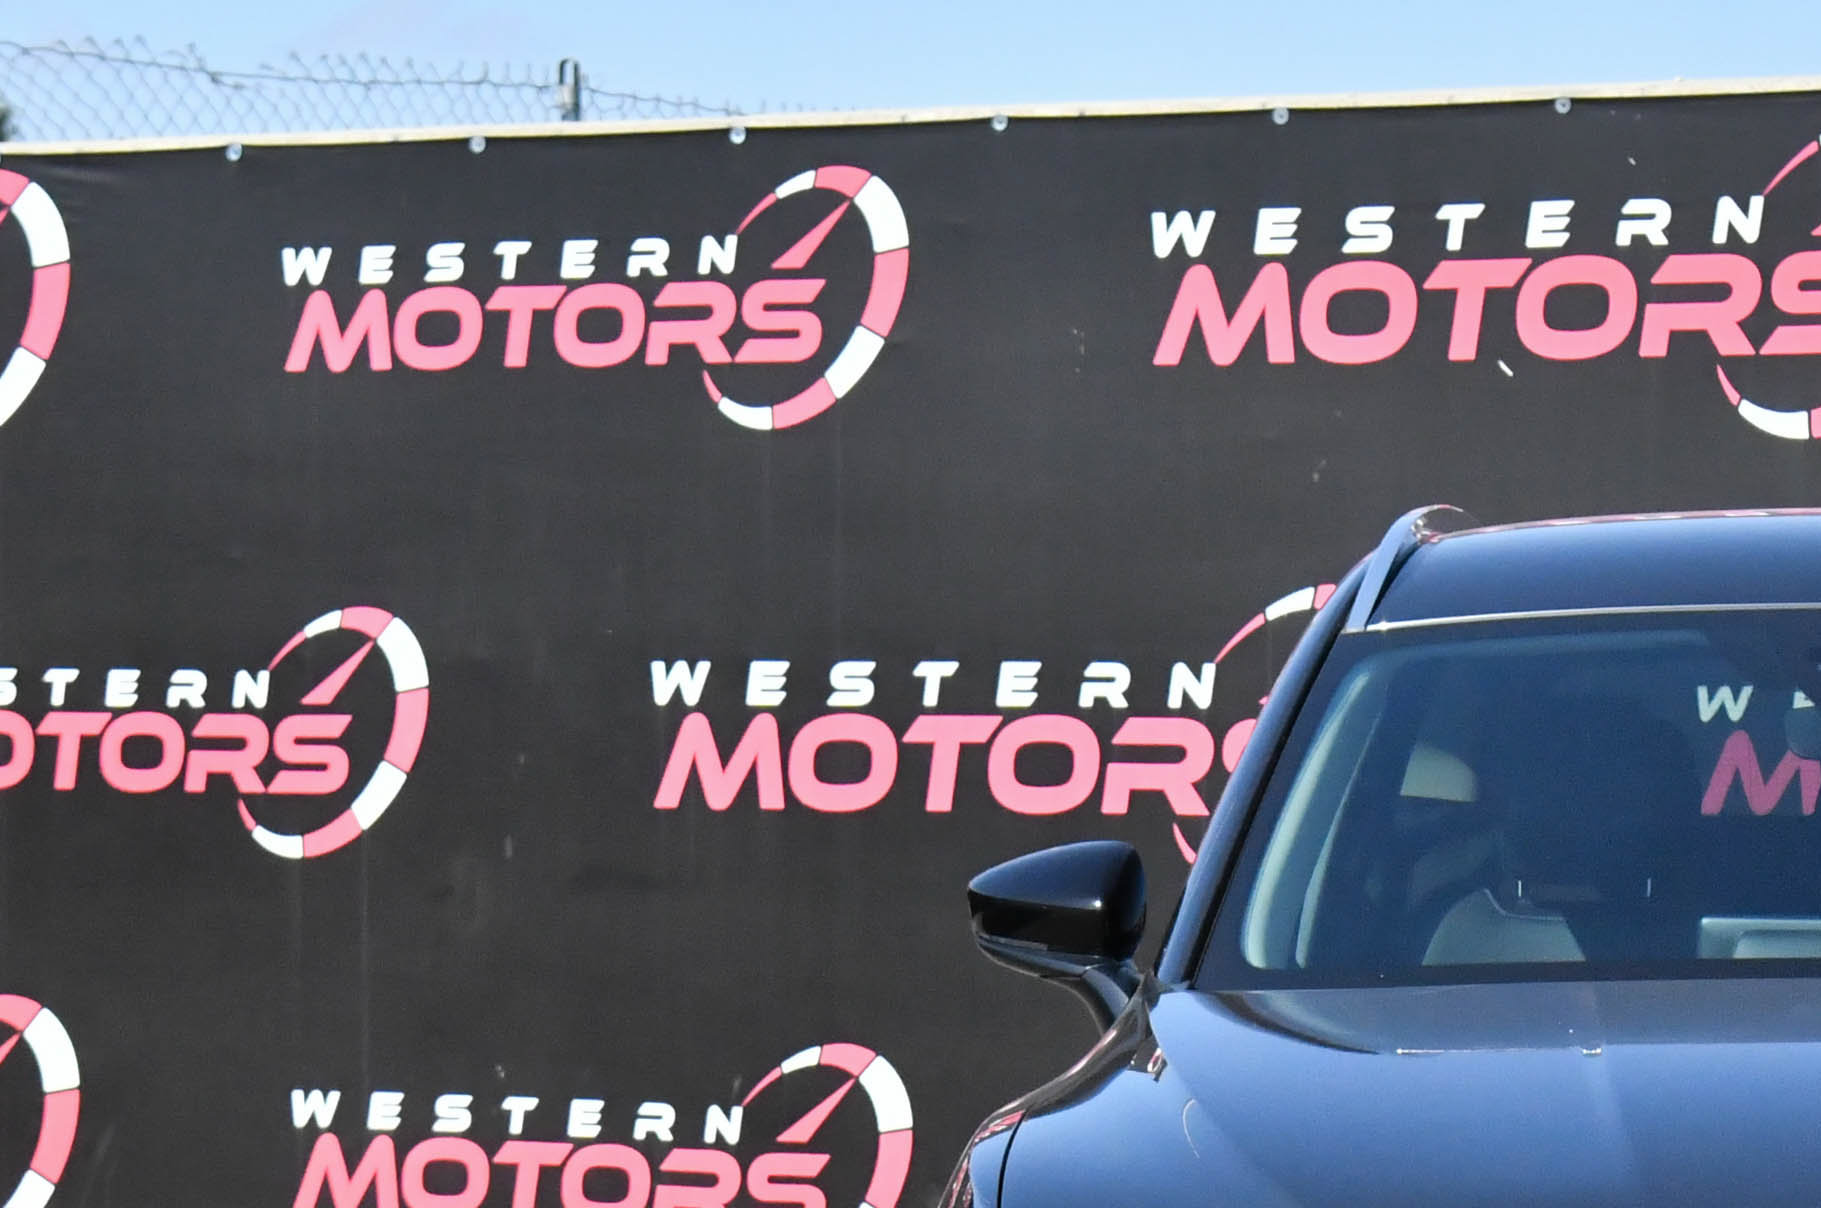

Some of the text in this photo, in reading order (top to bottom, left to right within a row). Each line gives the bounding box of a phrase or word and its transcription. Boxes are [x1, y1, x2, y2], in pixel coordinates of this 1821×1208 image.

[1151, 195, 1765, 259] WESTERN
[281, 234, 738, 287] WESTERN
[284, 278, 827, 374] MOTORS
[650, 660, 1217, 710] WESTERN
[291, 1089, 743, 1145] WESTERN
